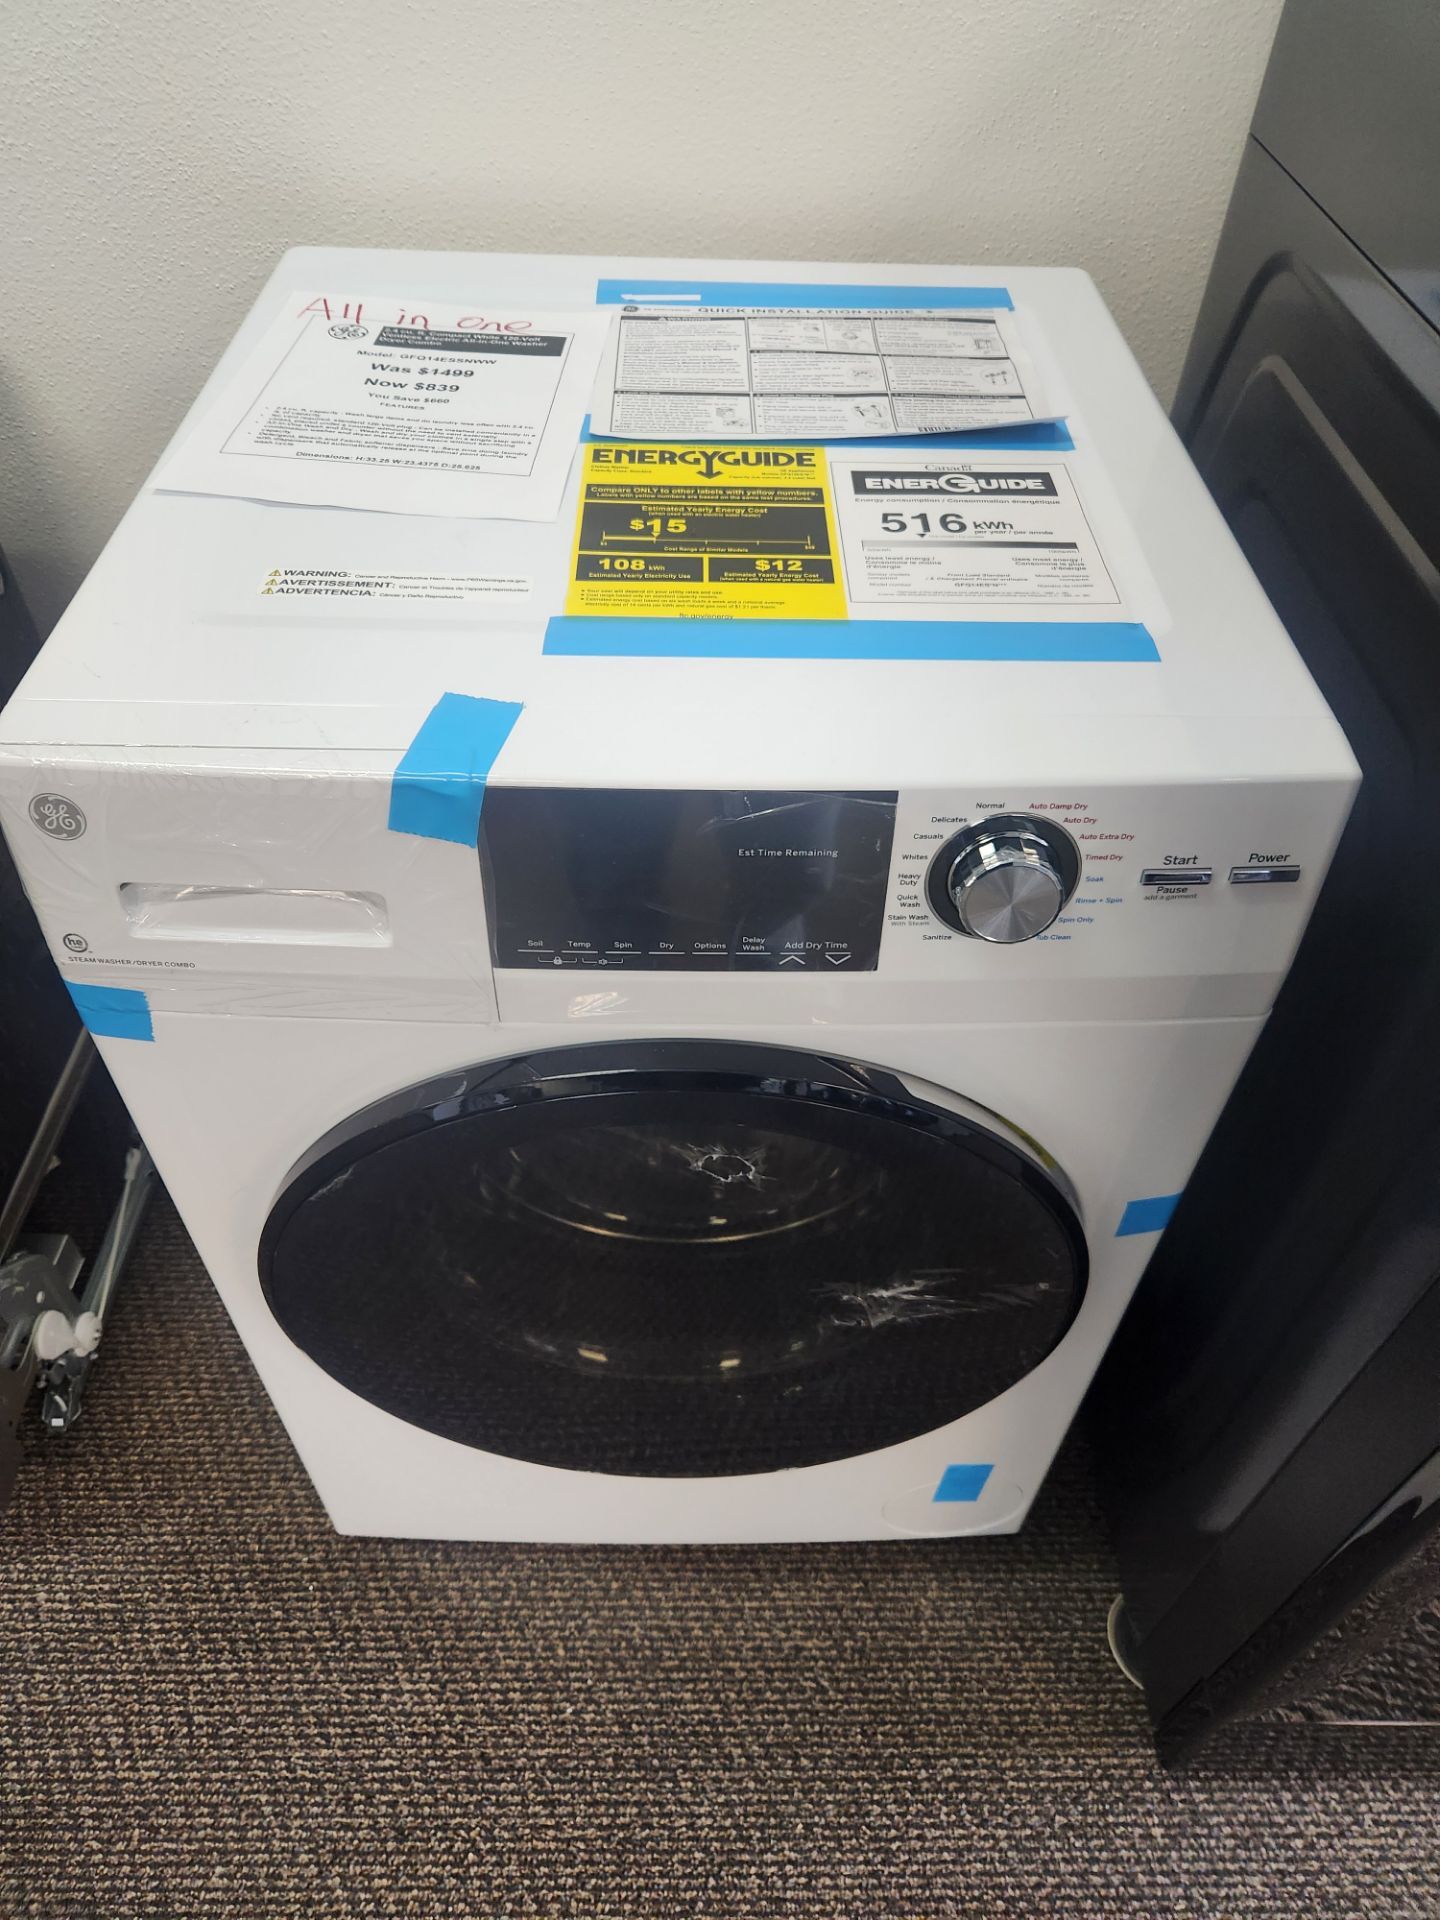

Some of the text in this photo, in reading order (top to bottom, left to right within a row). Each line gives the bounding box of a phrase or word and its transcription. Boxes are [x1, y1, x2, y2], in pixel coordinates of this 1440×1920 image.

[697, 307, 745, 315] QUICK
[298, 298, 533, 336] All in one
[371, 362, 475, 378] Was $1499
[364, 377, 460, 393] Now $839
[369, 392, 389, 400] You
[394, 395, 420, 403] Save
[380, 402, 424, 410] FEATURES
[296, 451, 352, 460] Dimensions:
[592, 448, 816, 470] ENERGYGUIDE
[865, 474, 1047, 493] ENERGUIDE
[591, 486, 632, 494] Compare
[686, 506, 714, 514] Yearly
[715, 507, 747, 515] Energy
[629, 517, 687, 534] $15
[881, 513, 1014, 534] 516 kWh
[599, 558, 645, 571] 108
[755, 559, 802, 572] $12
[278, 579, 396, 589] AVERTISSEMENT:
[275, 588, 375, 597] ADVERTENCIA:
[975, 802, 1006, 810] Normal
[1050, 803, 1073, 812] Damp
[1074, 803, 1089, 812] Dry
[931, 816, 968, 824] Delicates
[1063, 816, 1097, 825] Auto Dry
[913, 832, 944, 840] Casuals
[1078, 833, 1135, 842] Auto Extra Dry
[738, 848, 838, 859] Est Time Remaining
[1086, 853, 1123, 862] Timed Dry
[1248, 852, 1290, 864] Power
[1163, 855, 1198, 866] Start
[898, 873, 921, 881] Heavy
[899, 880, 918, 888] Duty
[1156, 886, 1188, 894] Pause
[1105, 897, 1122, 905] Spin
[1165, 893, 1198, 902] garment
[887, 914, 929, 922] Stain Wash
[1058, 917, 1094, 925] Spin Only
[66, 937, 84, 947] he
[742, 937, 766, 945] Delay
[923, 934, 954, 942] Sanitize
[1037, 934, 1073, 942] Tub Clean
[567, 941, 591, 949] Temp
[613, 941, 633, 950] Spin
[659, 942, 674, 951] Dry
[693, 942, 727, 951] Options
[805, 942, 823, 951] Dry
[825, 942, 848, 950] Time
[68, 956, 97, 964] STEAM
[98, 957, 163, 967] WASHER/DRYER
